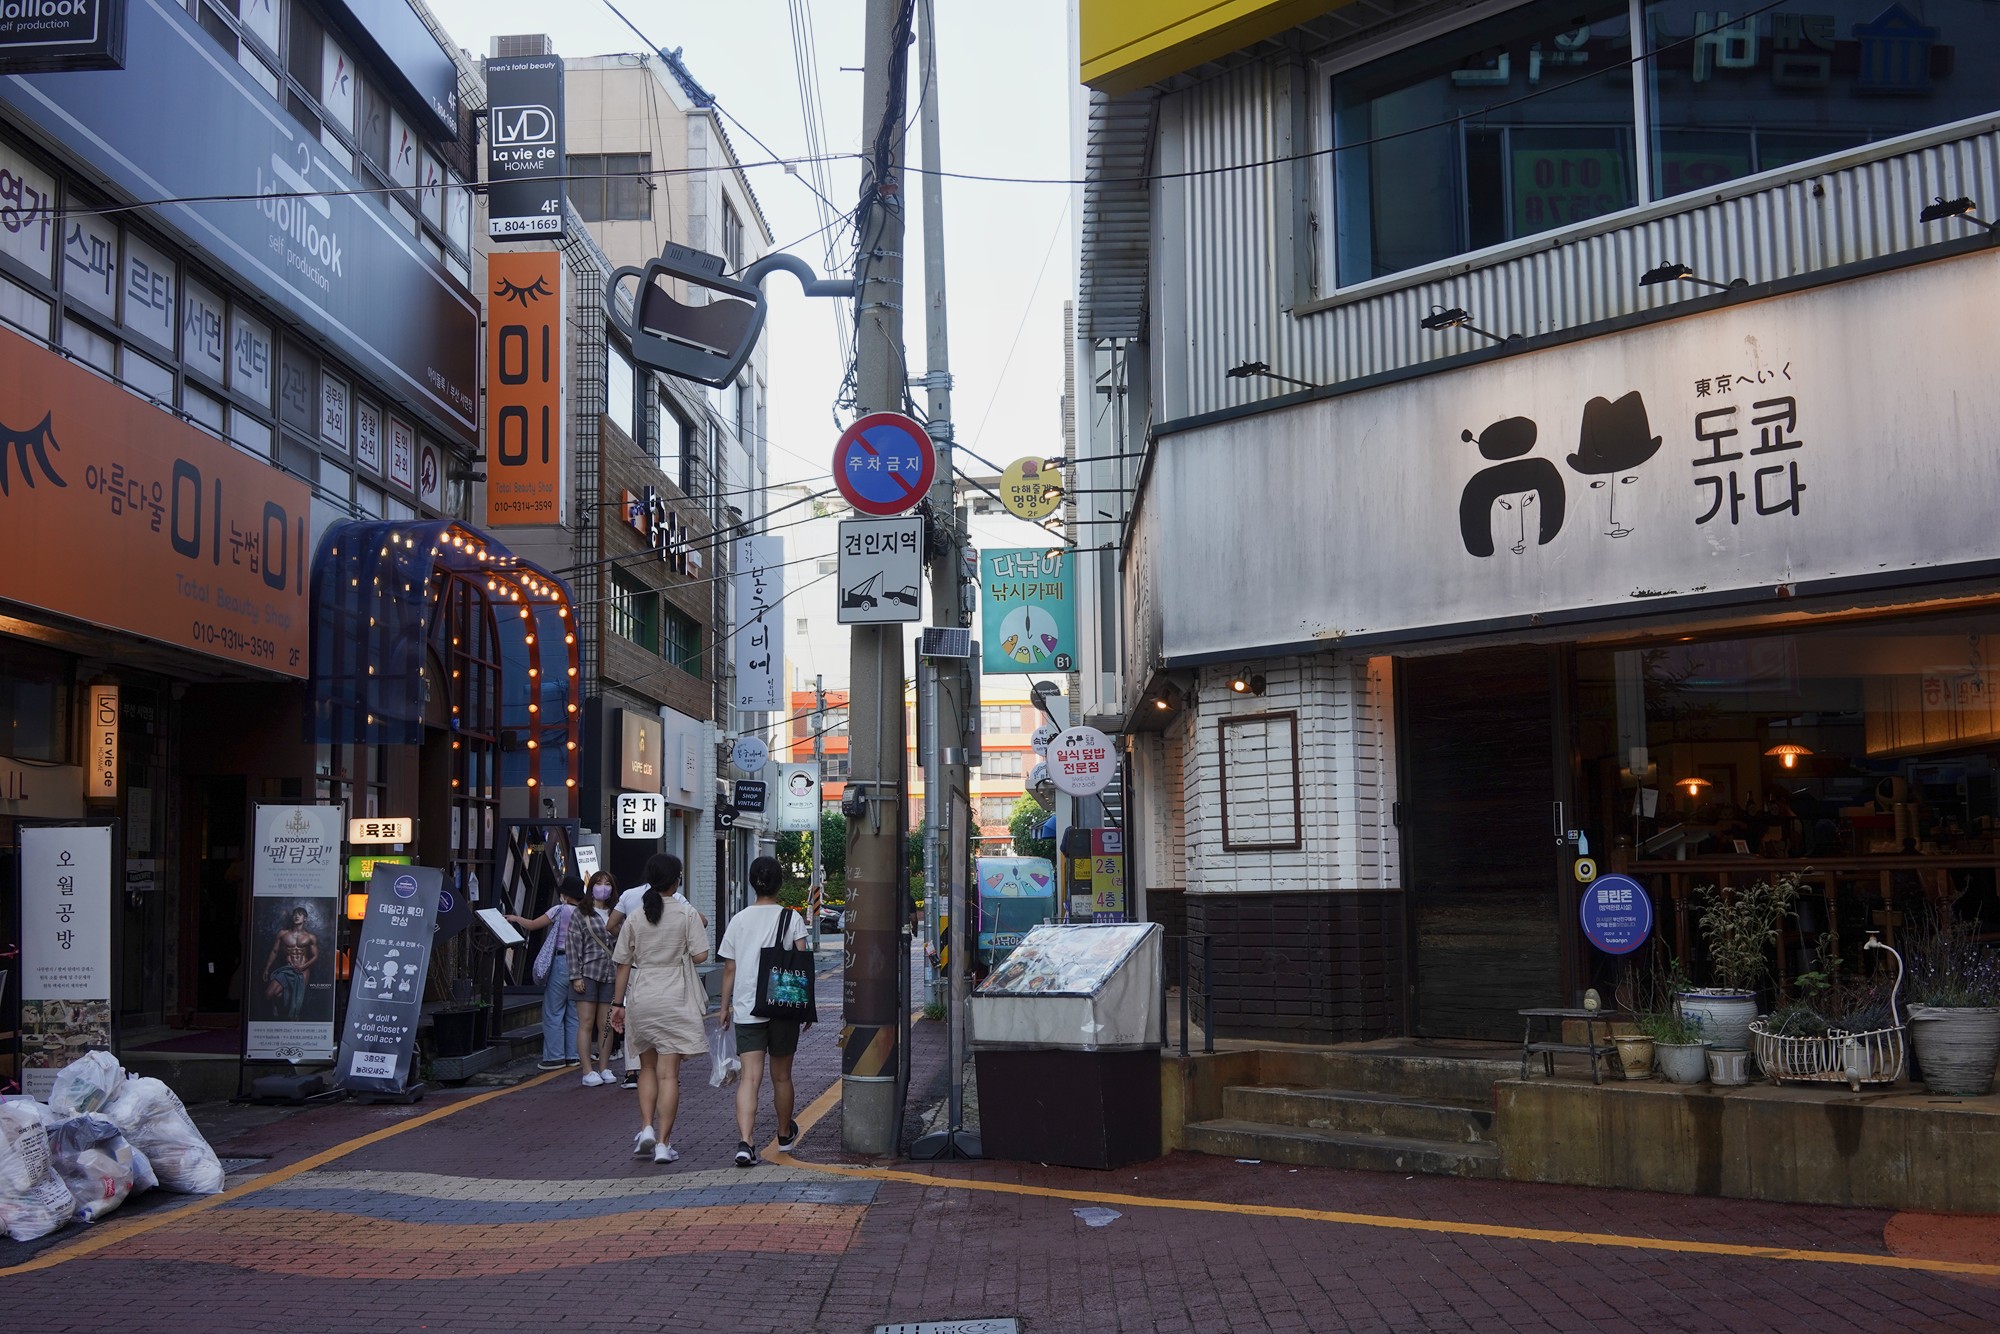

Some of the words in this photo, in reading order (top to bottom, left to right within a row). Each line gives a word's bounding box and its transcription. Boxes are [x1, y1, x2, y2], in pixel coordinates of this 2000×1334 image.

[17, 19, 70, 32] production
[489, 64, 511, 72] men's
[512, 63, 528, 71] total
[530, 62, 556, 71] beauty
[493, 150, 508, 162] La
[512, 148, 532, 160] vie
[537, 147, 555, 159] de
[505, 161, 544, 170] HOMME
[541, 200, 559, 213] 4F
[492, 222, 501, 232] T.
[505, 219, 558, 231] 804-1669
[268, 234, 285, 256] self
[286, 248, 330, 293] production
[185, 298, 222, 363] 서면
[234, 327, 269, 389] 센터
[1694, 361, 1792, 398] 東京へいく
[325, 383, 344, 411] 공무원
[326, 408, 343, 435] 과외
[1692, 395, 1804, 467] 도쿄
[361, 435, 375, 460] 과외
[849, 456, 920, 472] 주차금지
[1694, 461, 1807, 525] 가다
[495, 500, 553, 512] 010-9314-3599
[85, 462, 165, 533] 아름다울
[229, 519, 259, 574] 눈썹
[845, 530, 917, 556] 견인지역
[991, 582, 1064, 601] 낚시카페
[176, 573, 210, 603] Total
[217, 588, 259, 625] Beauty
[265, 604, 292, 632] Shop
[193, 621, 275, 660] 010-9314-3599
[289, 648, 300, 667] 2F
[1057, 656, 1070, 668] B1
[742, 696, 754, 705] 2F
[105, 732, 114, 745] La
[105, 750, 114, 767] vie
[1057, 749, 1080, 761] 일식
[1082, 748, 1106, 760] 덮밥
[1064, 762, 1099, 774] 전문점
[0, 771, 28, 800] IL
[104, 771, 114, 787] de
[622, 798, 657, 813] 전자
[622, 818, 656, 834] 담배
[274, 836, 320, 844] FANDOMFIT
[263, 844, 332, 864] "팬덤핏"
[56, 850, 75, 950] 오월공방
[1096, 892, 1115, 908] 4층
[1597, 889, 1633, 903] 클린존
[379, 903, 405, 915] 데일리
[391, 916, 408, 927] 완성
[767, 998, 808, 1008] MONET
[375, 1014, 390, 1022] doll
[361, 1023, 375, 1031] doll
[376, 1025, 400, 1034] closet
[364, 1034, 378, 1042] doll
